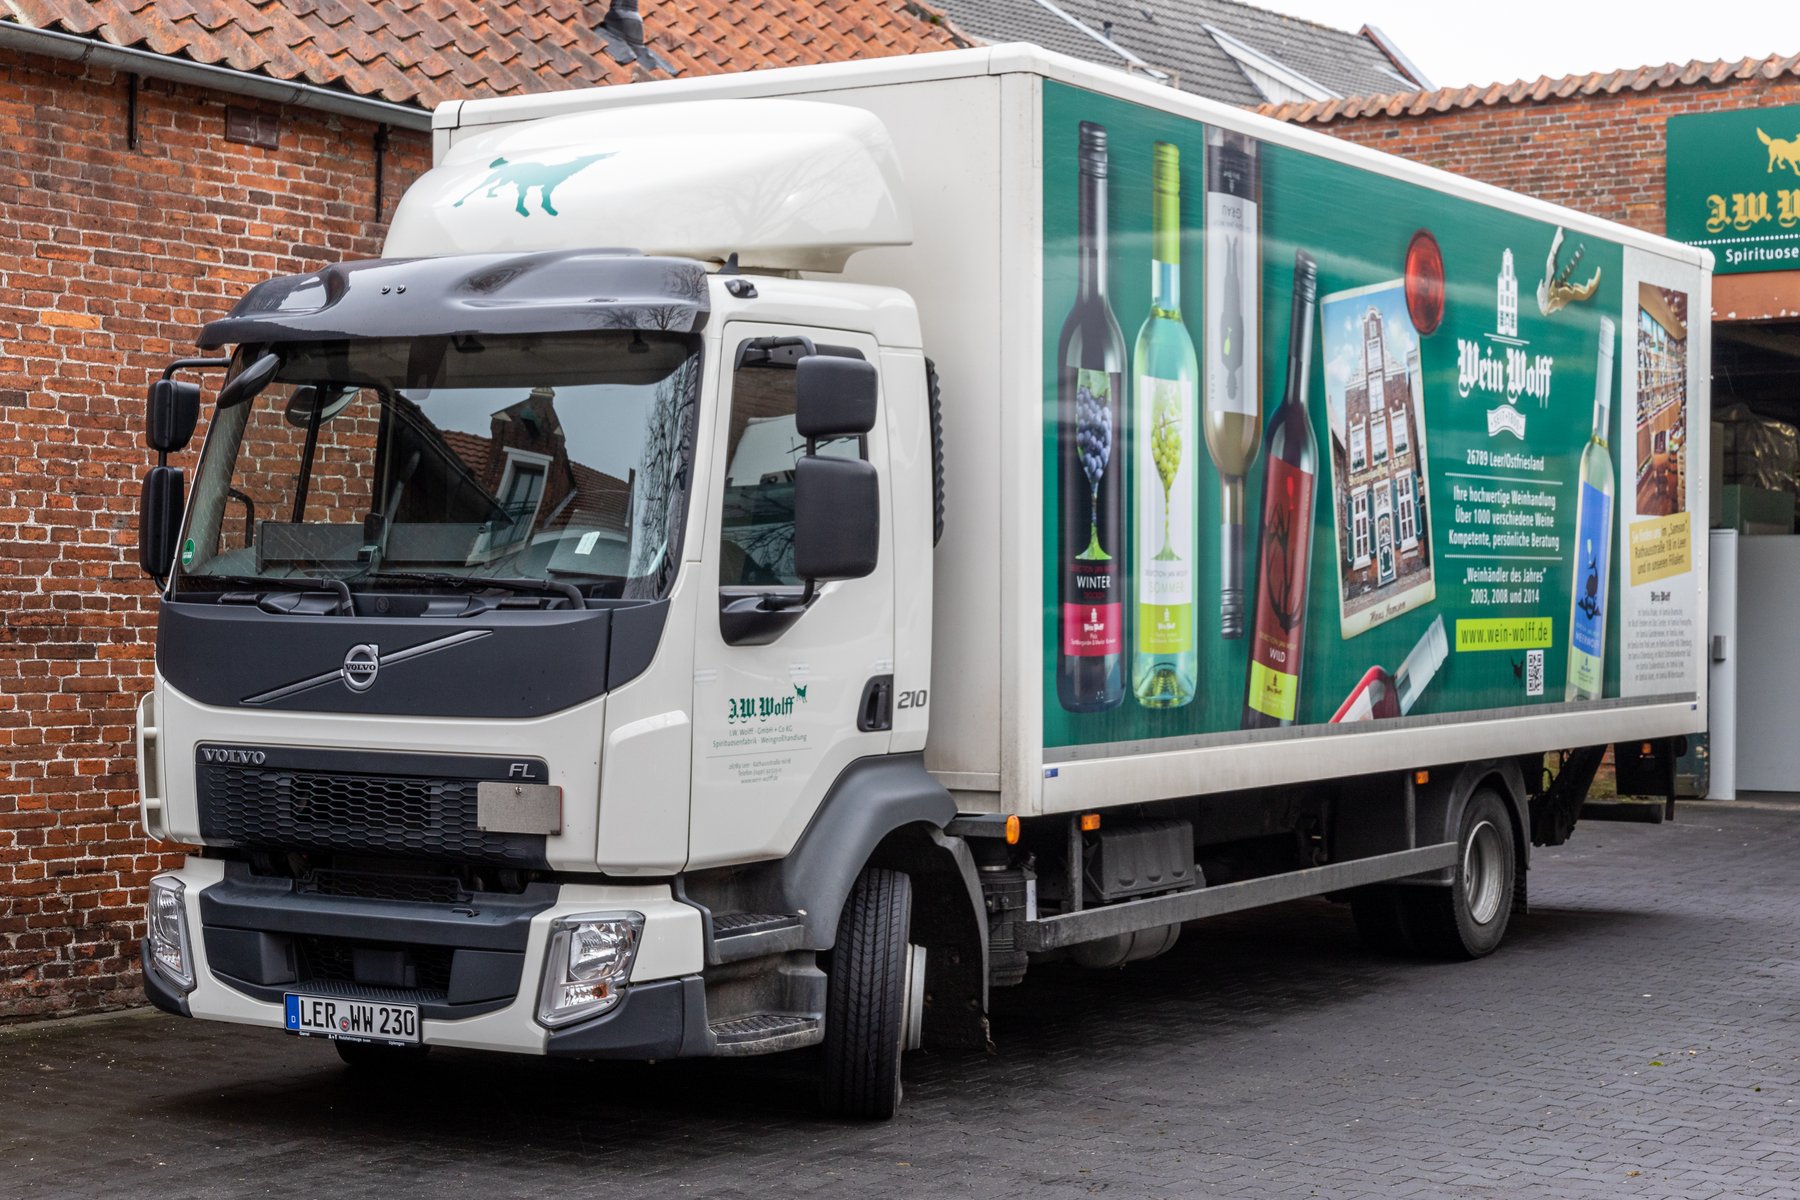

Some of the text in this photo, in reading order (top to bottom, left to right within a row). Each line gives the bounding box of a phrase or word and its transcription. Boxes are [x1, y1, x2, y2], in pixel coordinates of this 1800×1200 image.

[1457, 338, 1553, 408] Wein Wolff
[1466, 449, 1544, 471] 26789 Leer/Ostfriesland
[1453, 485, 1556, 511] Ihre hochwertige Weinhandlung
[1455, 504, 1554, 527] Über 1000 verschiedene Weine
[1492, 531, 1530, 550] persönliche
[1531, 533, 1560, 551] Beratung
[1076, 575, 1112, 589] WINTER
[1510, 567, 1522, 582] des
[1491, 589, 1509, 604] 2008
[1509, 589, 1522, 604] und
[1523, 589, 1540, 603] 2014
[1461, 622, 1548, 644] www.wein-wolff.de
[1269, 647, 1286, 663] WILD
[345, 663, 376, 671] VOLVO
[759, 695, 795, 722] Wolff
[897, 690, 928, 710] 210
[202, 748, 266, 765] VOLVO
[508, 763, 536, 778] FL
[291, 1000, 415, 1036] D LER WW 230
